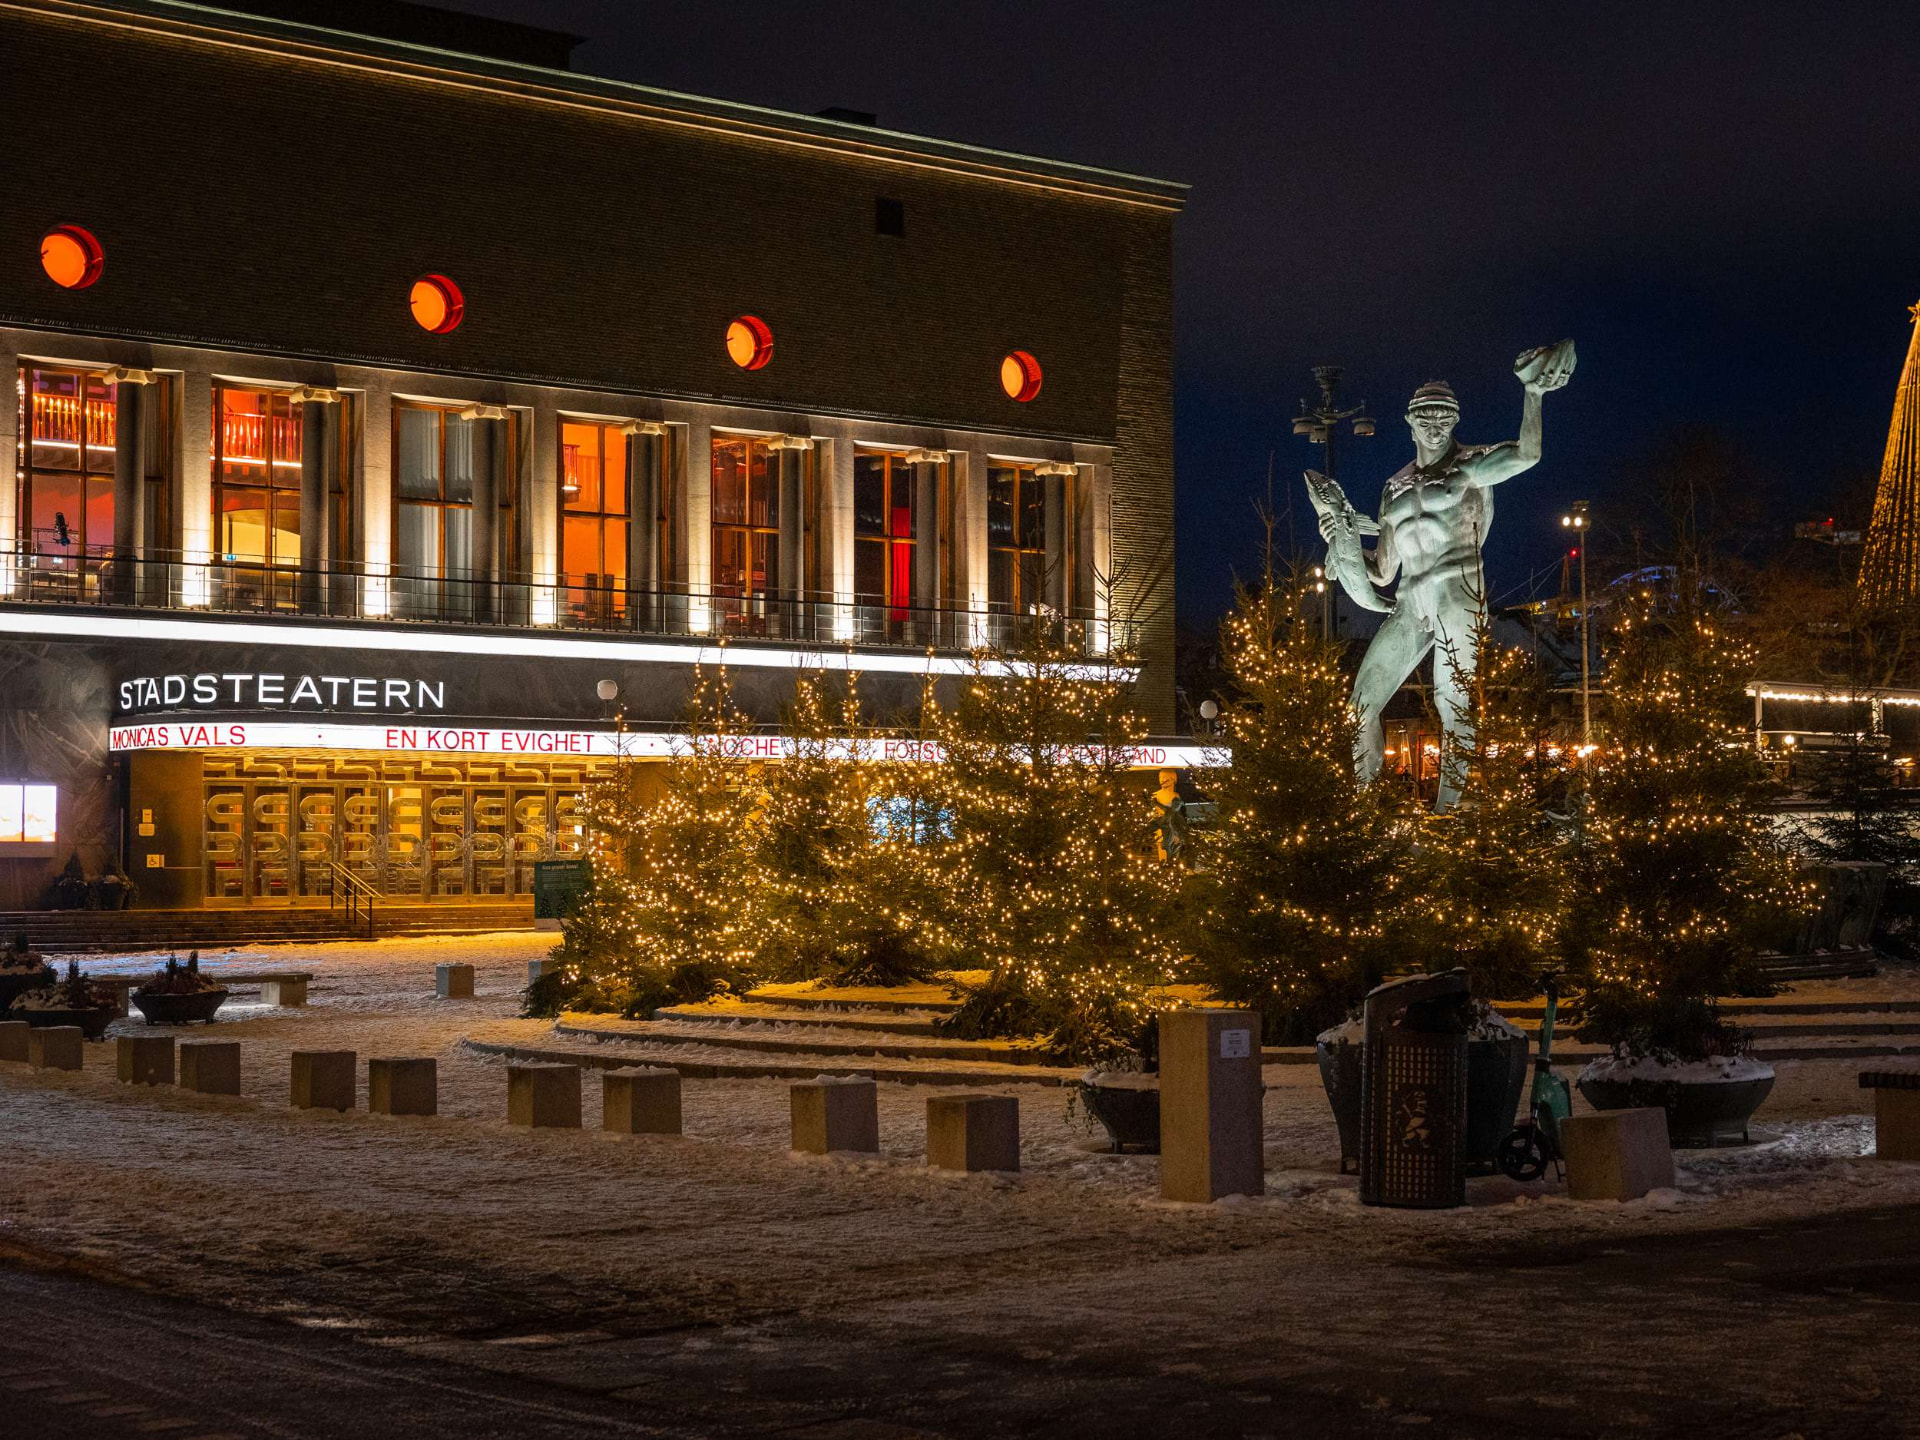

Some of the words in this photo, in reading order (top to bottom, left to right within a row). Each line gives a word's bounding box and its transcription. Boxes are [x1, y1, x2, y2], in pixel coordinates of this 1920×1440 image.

[120, 674, 444, 710] STADSTEATERN
[112, 726, 169, 750] MONICAS
[179, 725, 246, 746] VALS
[386, 729, 417, 749] EN
[427, 730, 490, 750] KORT
[501, 732, 595, 753] EVIGHET
